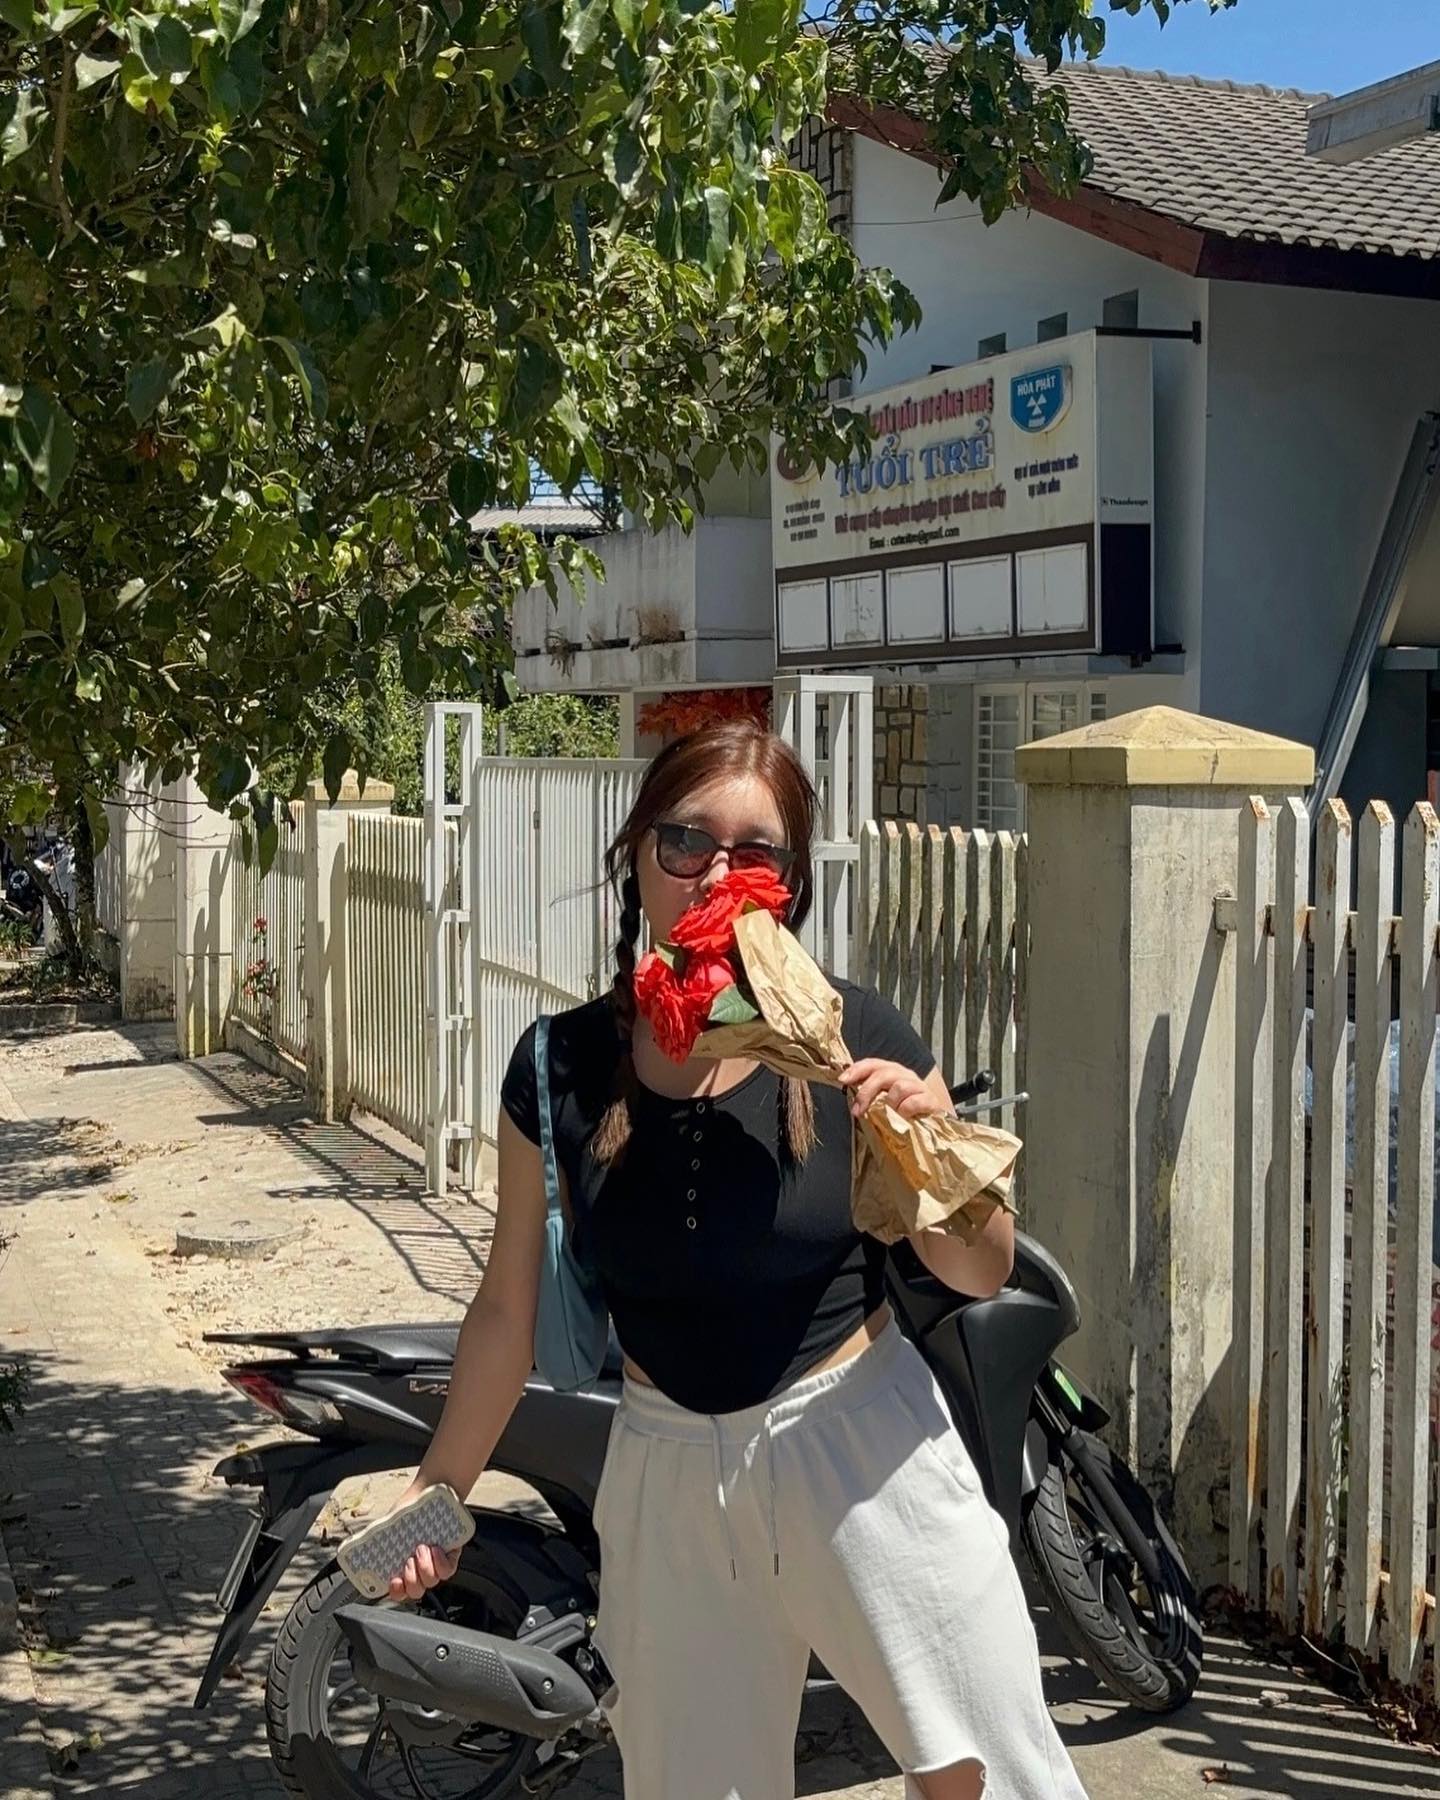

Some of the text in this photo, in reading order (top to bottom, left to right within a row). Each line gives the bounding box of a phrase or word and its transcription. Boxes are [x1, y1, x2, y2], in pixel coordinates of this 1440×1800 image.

[1017, 373, 1056, 397] HÒA PHÁT
[835, 434, 911, 497] TUỔI
[919, 416, 992, 481] TRẺ
